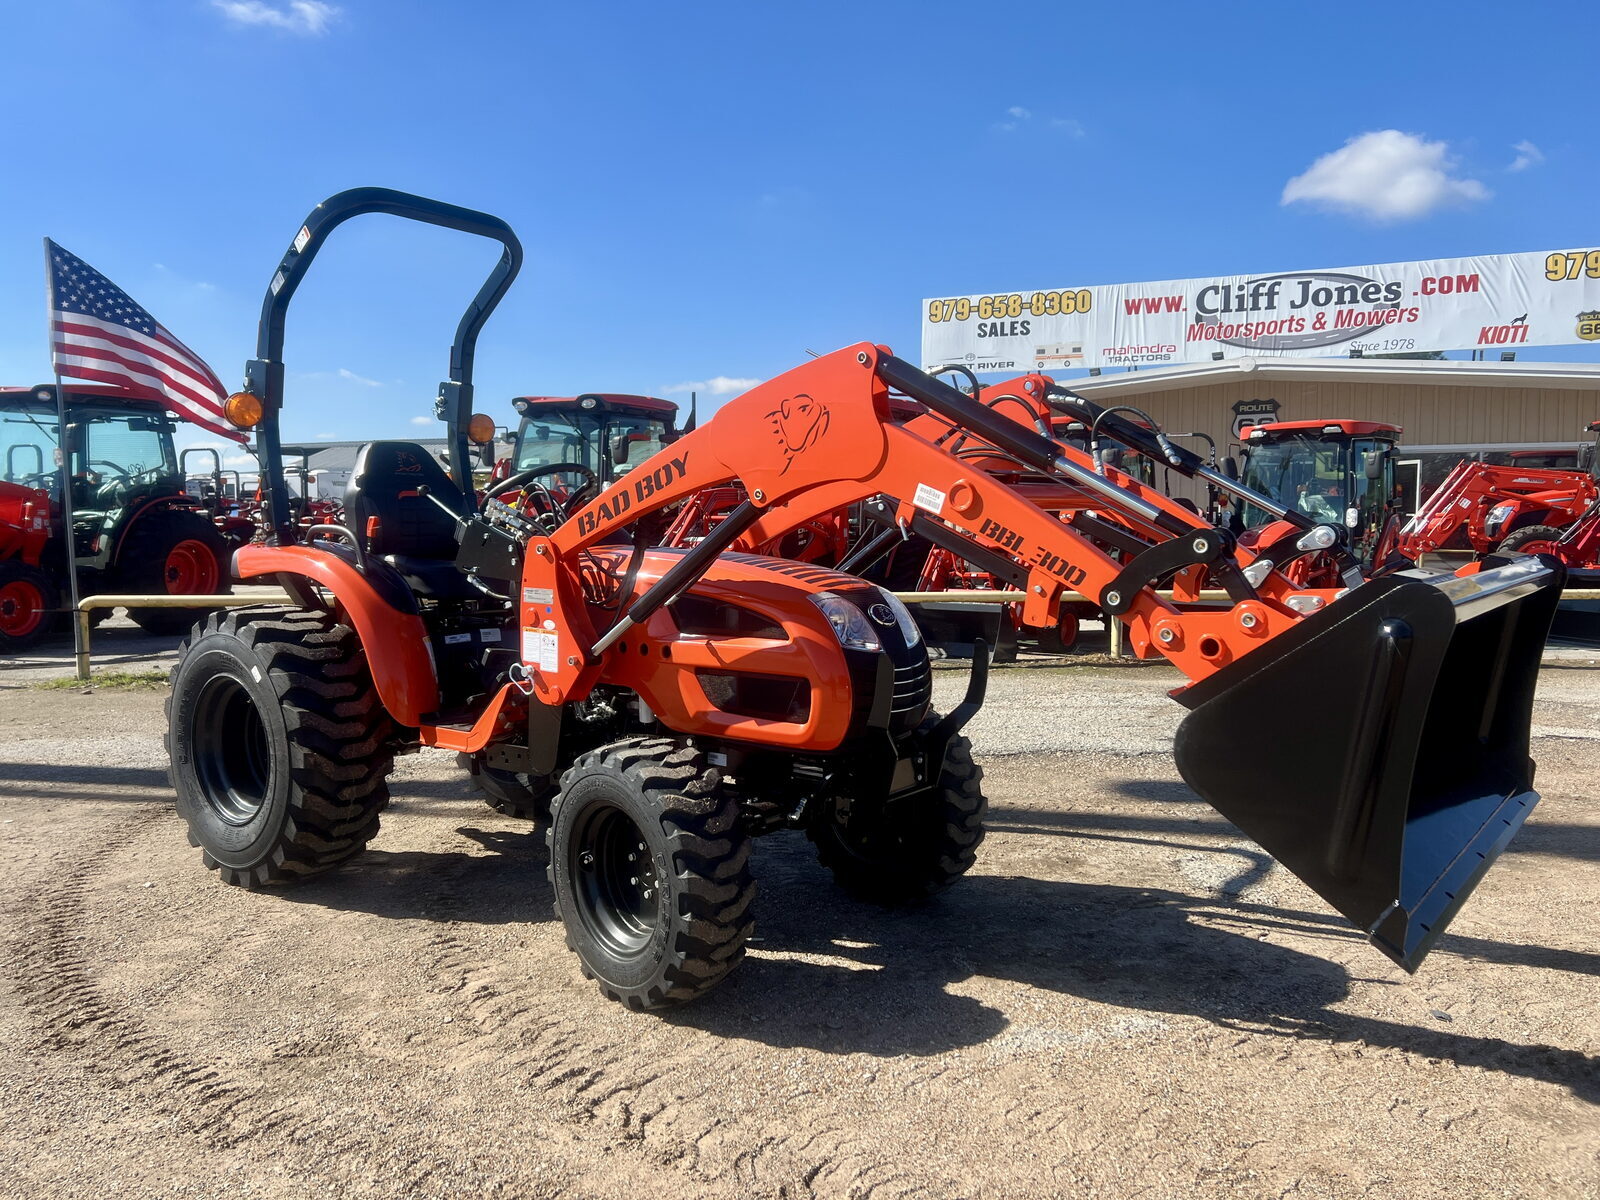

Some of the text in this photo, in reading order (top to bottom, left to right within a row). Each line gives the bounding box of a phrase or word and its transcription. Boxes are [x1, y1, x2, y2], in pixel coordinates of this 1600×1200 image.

[1196, 281, 1282, 314] Cliff
[1290, 280, 1402, 309] Jones
[1413, 274, 1479, 296] .COM
[929, 289, 1092, 323] 979-658-8360
[977, 320, 1031, 338] SALES
[1187, 307, 1419, 342] Motorsports & Mowers
[1477, 324, 1529, 344] KIOTI
[1103, 344, 1176, 356] mahindra
[1350, 338, 1415, 352] Since 1978
[977, 361, 1015, 370] RIVER
[1108, 354, 1171, 363] TRACTORS
[1240, 404, 1273, 412] ROUTE
[577, 450, 689, 537] BAD BOY
[979, 518, 1087, 586] BBL 300
